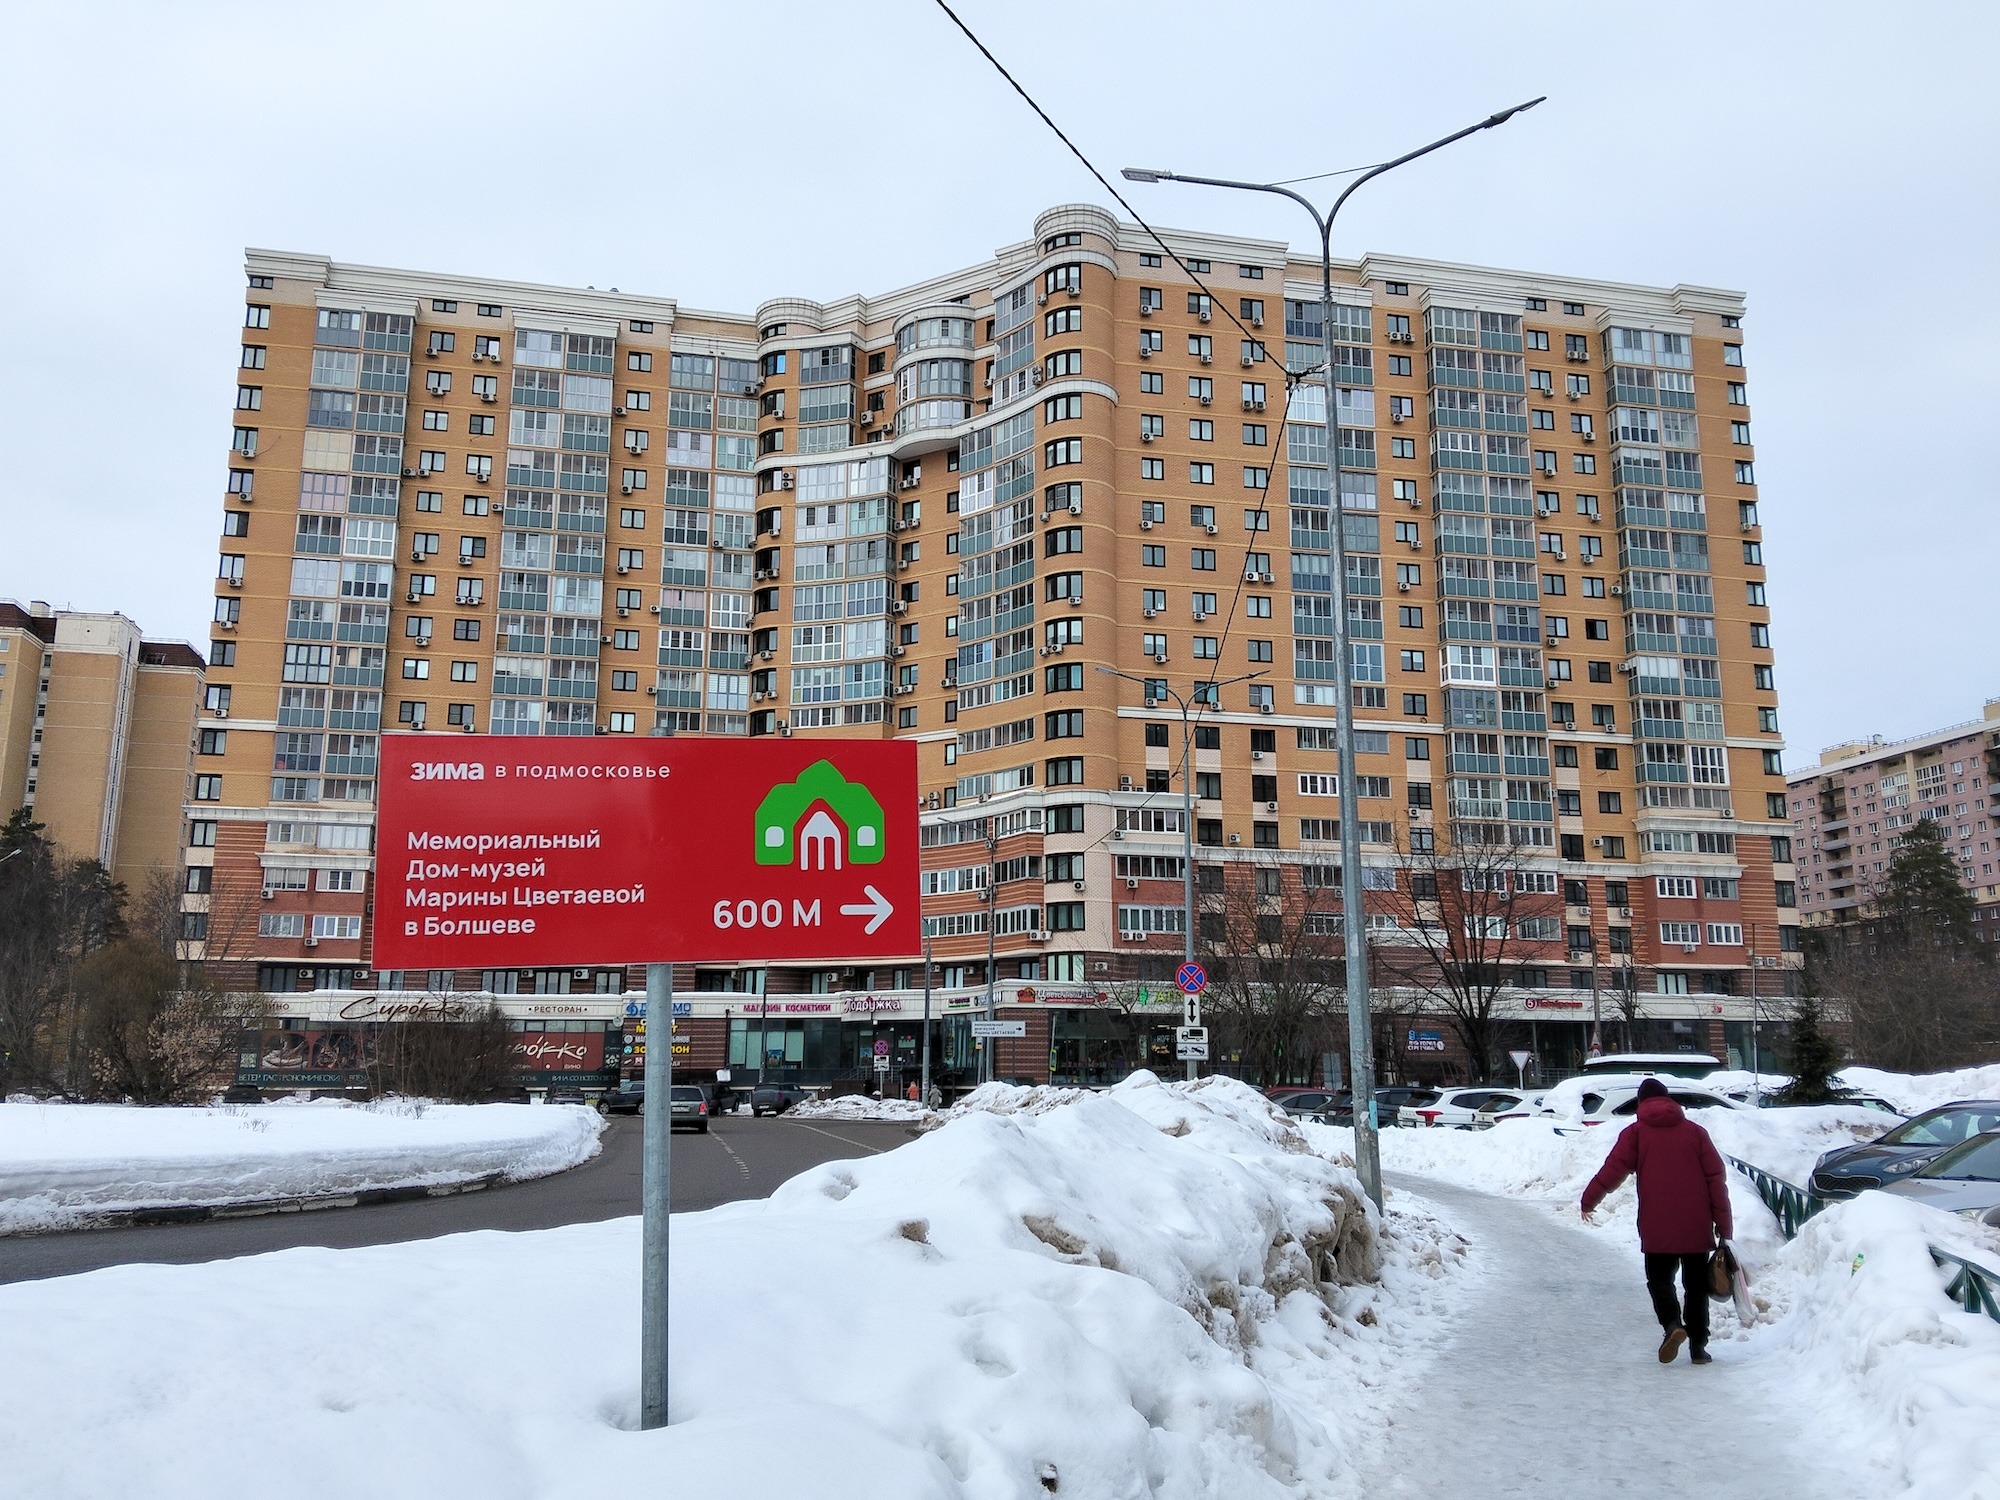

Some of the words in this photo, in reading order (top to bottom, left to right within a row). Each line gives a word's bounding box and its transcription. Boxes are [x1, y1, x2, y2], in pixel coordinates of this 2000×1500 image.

[410, 762, 485, 781] зима
[495, 765, 507, 778] в
[515, 765, 671, 780] подмосковье
[407, 829, 601, 854] Мемориальный
[405, 857, 546, 883] Дом-музей
[405, 887, 507, 912] Марины
[513, 883, 645, 908] Цветаевой
[713, 899, 783, 929] 600
[404, 921, 419, 936] в
[424, 916, 536, 936] Болшеве
[743, 1004, 781, 1012] МАГАЗИН
[785, 1003, 831, 1012] КОСМЕТИКИ
[844, 997, 901, 1013] Подружка
